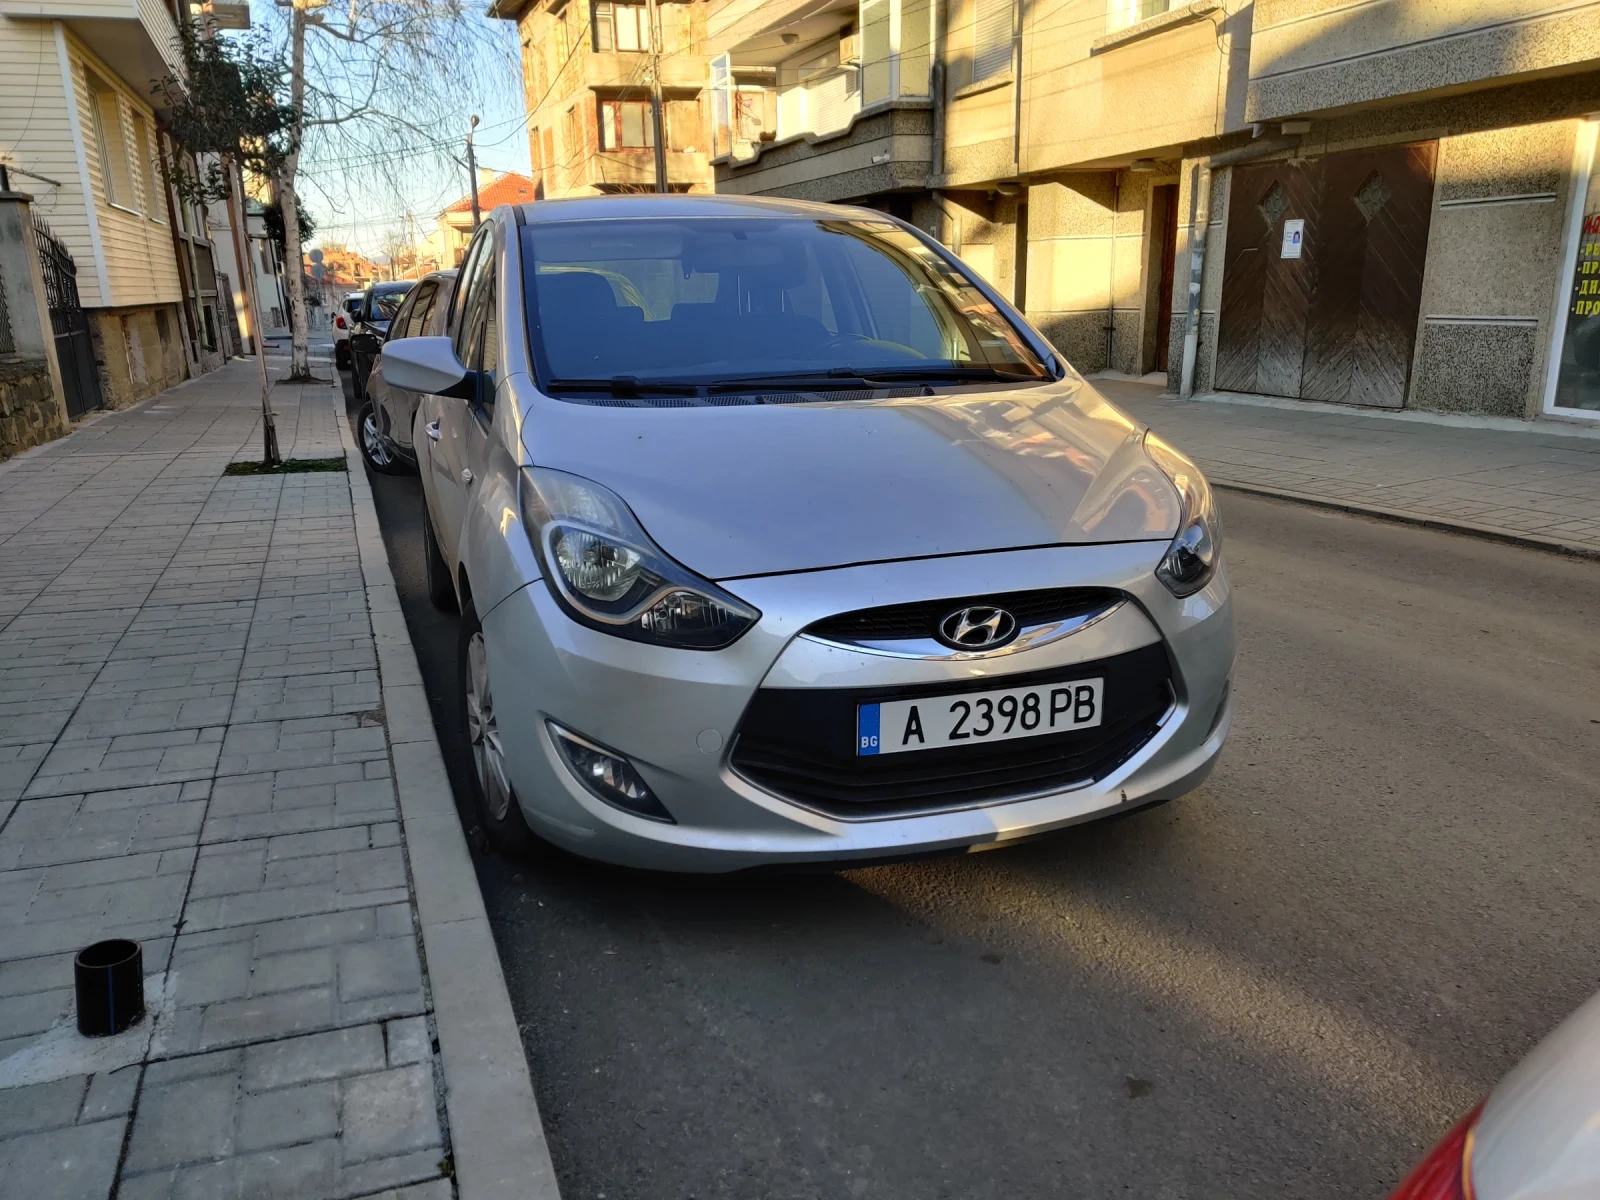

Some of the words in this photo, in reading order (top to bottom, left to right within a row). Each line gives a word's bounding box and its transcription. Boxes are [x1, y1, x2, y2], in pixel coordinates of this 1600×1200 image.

[901, 705, 926, 746] A
[948, 692, 1041, 741] 2398
[1049, 685, 1096, 727] PB
[860, 735, 878, 749] BG
